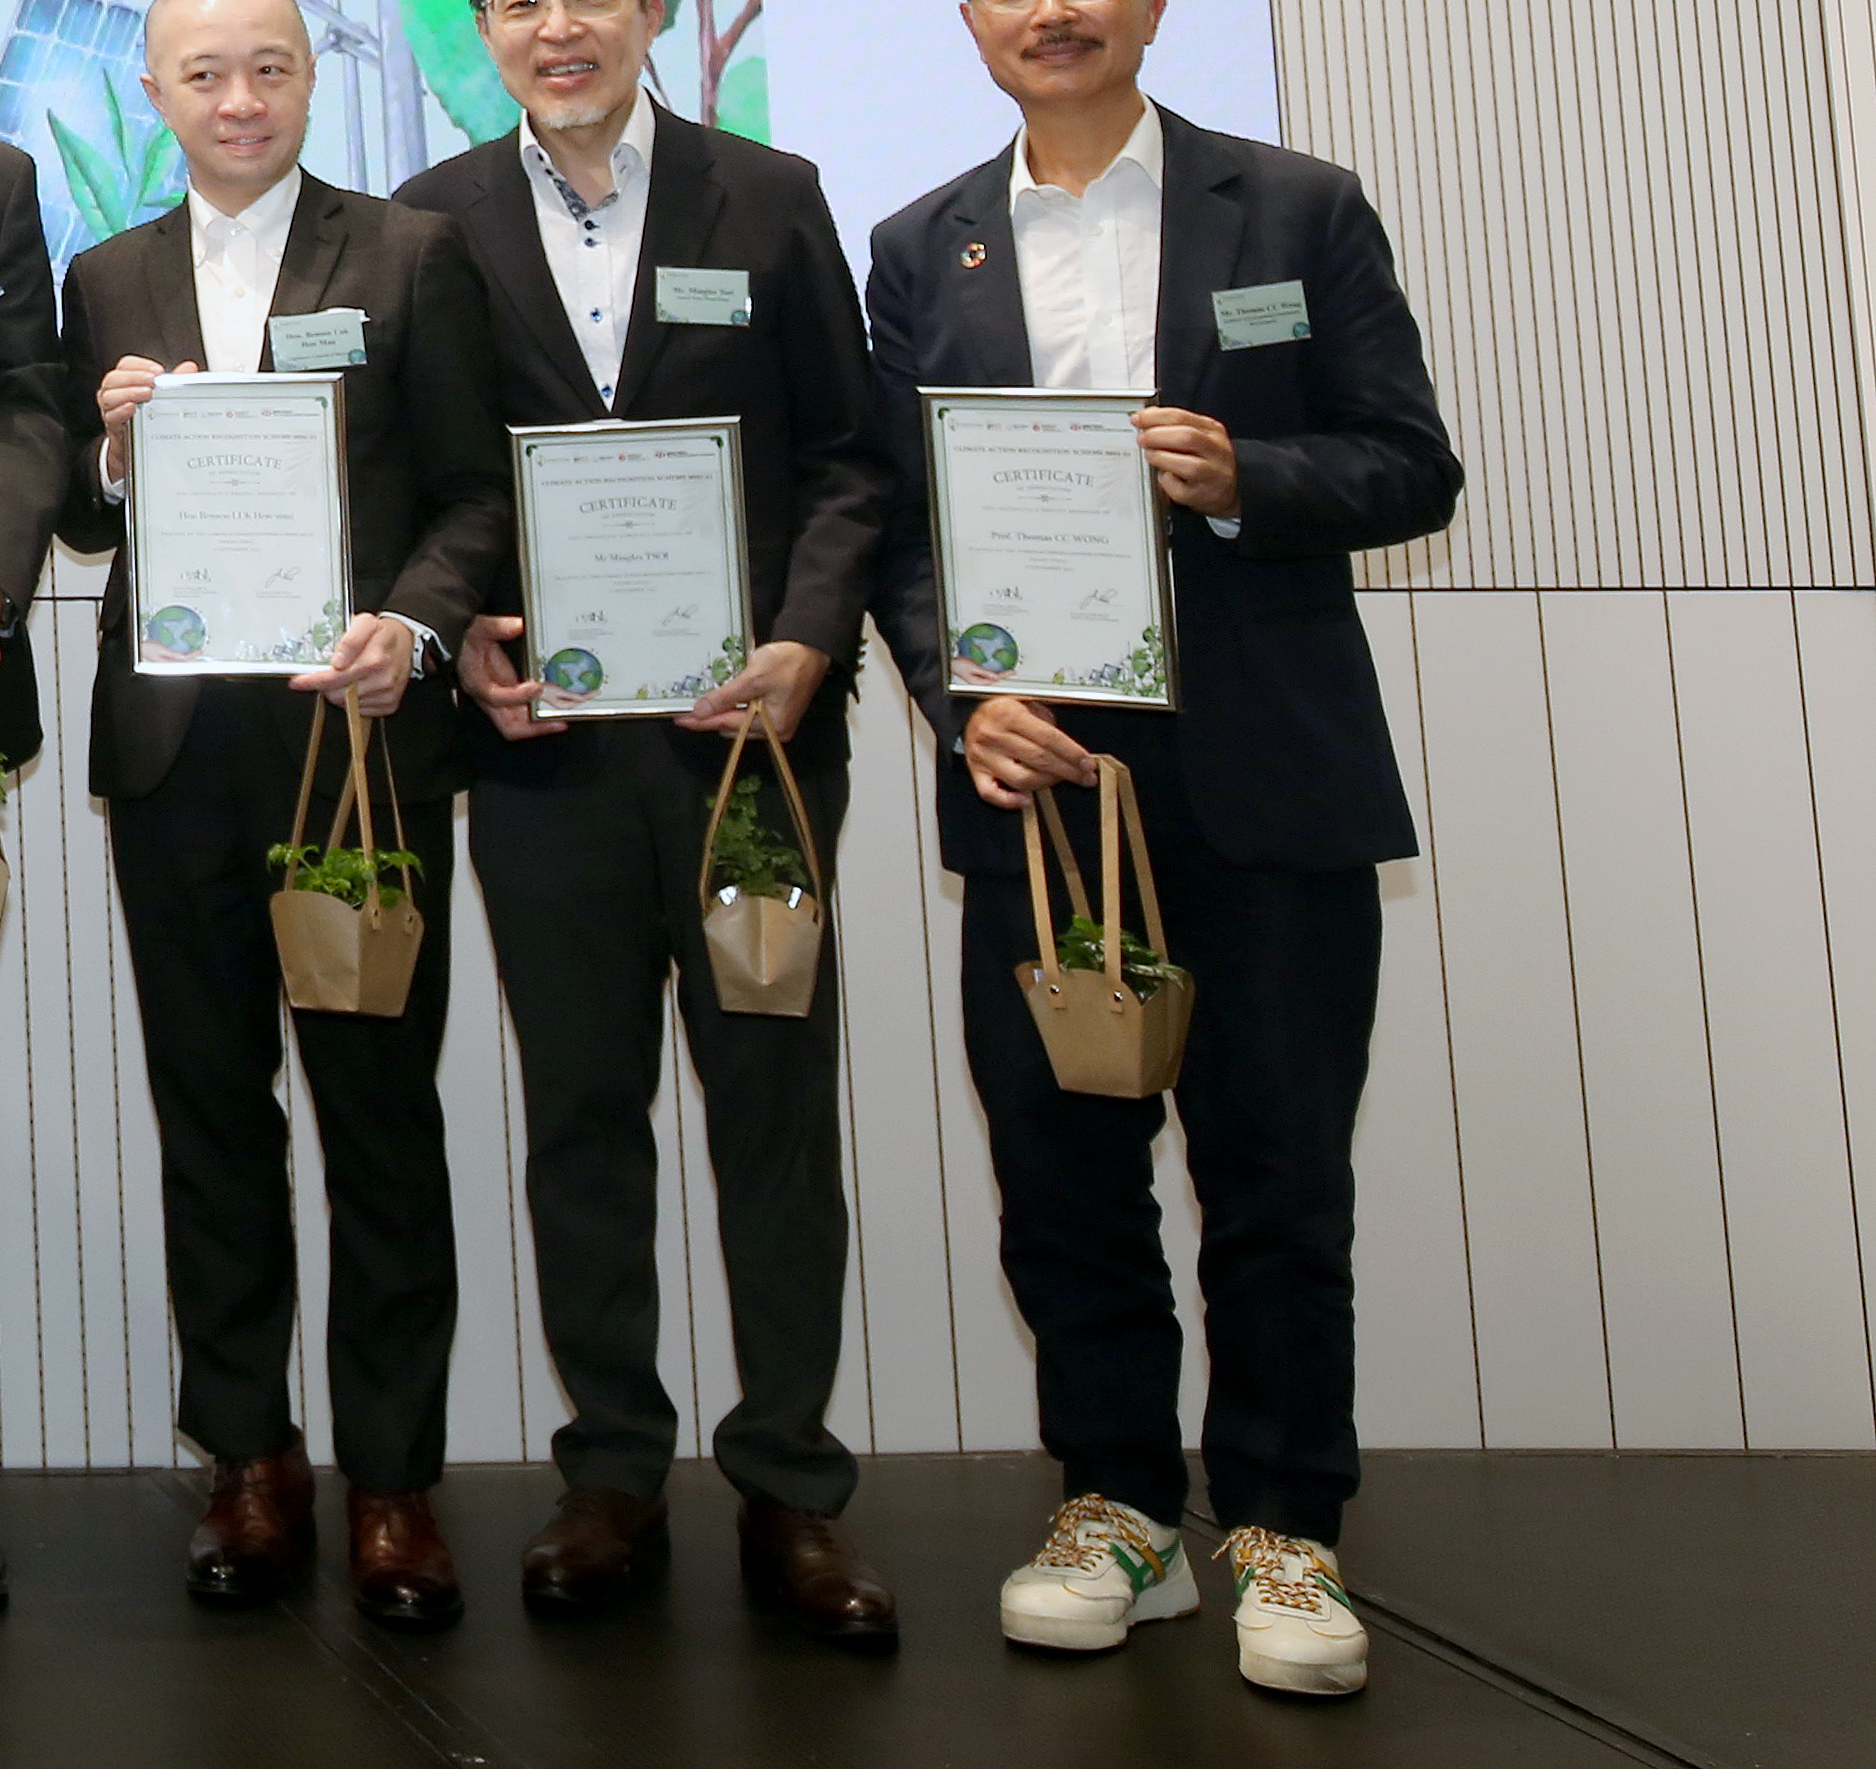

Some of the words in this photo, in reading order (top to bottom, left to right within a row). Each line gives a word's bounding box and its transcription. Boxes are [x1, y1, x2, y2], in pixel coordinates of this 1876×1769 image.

[187, 454, 282, 470] CERTIFICATE
[993, 469, 1094, 487] CERTIFICATE
[579, 497, 677, 514] CERTIFICATE
